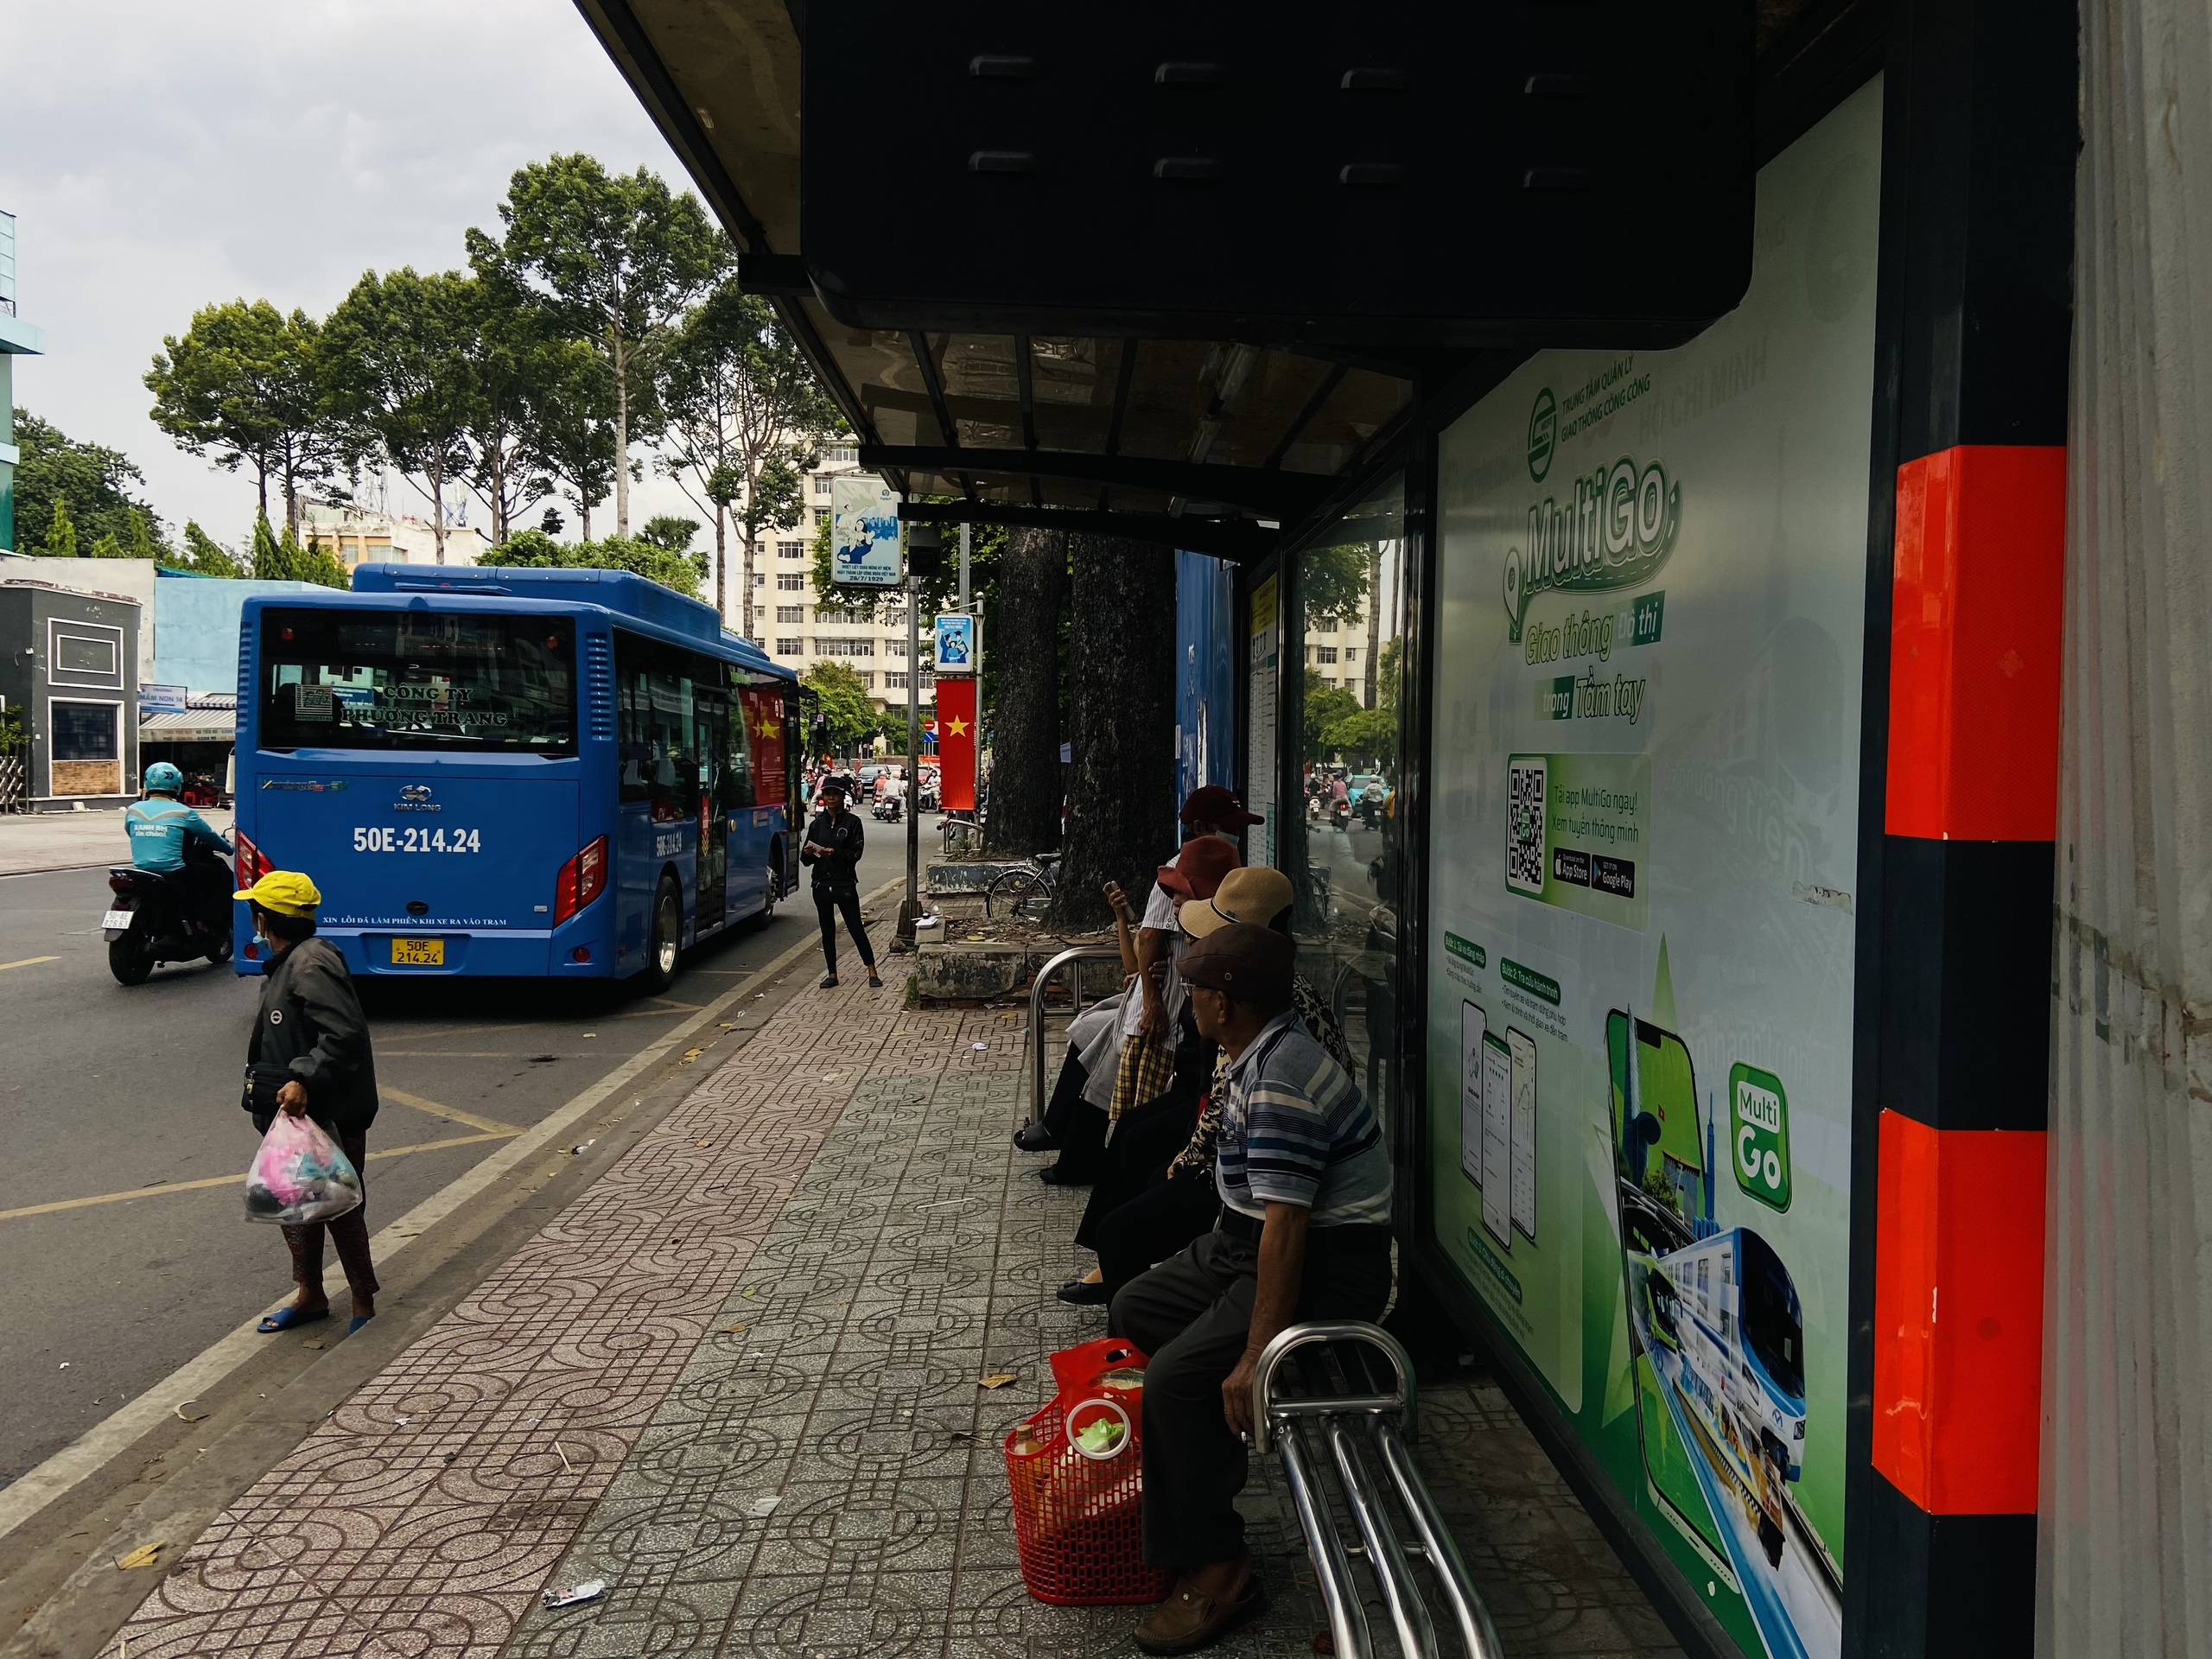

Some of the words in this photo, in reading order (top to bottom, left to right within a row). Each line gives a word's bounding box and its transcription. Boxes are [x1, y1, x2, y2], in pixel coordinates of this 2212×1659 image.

[1562, 388, 1584, 416] TRUNG
[1586, 378, 1600, 400] TÂM
[1601, 359, 1624, 391] QUẢN
[1624, 351, 1634, 375] LÝ
[1561, 420, 1577, 442] GIAO
[1579, 404, 1602, 432] THÔNG
[1604, 389, 1625, 416] CÔNG
[1627, 373, 1650, 404] CỘNG
[1526, 457, 1666, 590] MultiGo
[1525, 622, 1560, 665] Giao
[1563, 610, 1614, 662] thông
[1618, 608, 1635, 639] Đô
[1638, 601, 1658, 641] thị
[383, 682, 441, 701] CÔNG
[447, 687, 476, 702] TY
[1543, 690, 1570, 717] trong
[1576, 665, 1611, 718] Tầm
[1614, 673, 1646, 725] tay
[340, 706, 429, 723] PHƯƠNG
[433, 711, 508, 726] TRANG
[1554, 785, 1565, 804] Tải
[1566, 790, 1580, 809] app
[1581, 787, 1611, 808] MultiGo
[1613, 791, 1637, 816] ngay!
[353, 827, 480, 853] 50E-214.24
[1552, 813, 1567, 832] Xem
[1569, 812, 1590, 838] tuyến
[1592, 818, 1615, 844] thông
[1617, 821, 1639, 842] minh
[1562, 862, 1573, 879] App
[1573, 864, 1587, 880] Store
[1602, 871, 1620, 888] Google
[1620, 875, 1632, 893] Play
[463, 917, 480, 925] VÀO
[397, 950, 440, 964] 214.24
[406, 940, 429, 952] 50E
[1739, 1089, 1777, 1127] Multi
[1737, 1125, 1781, 1190] Go
